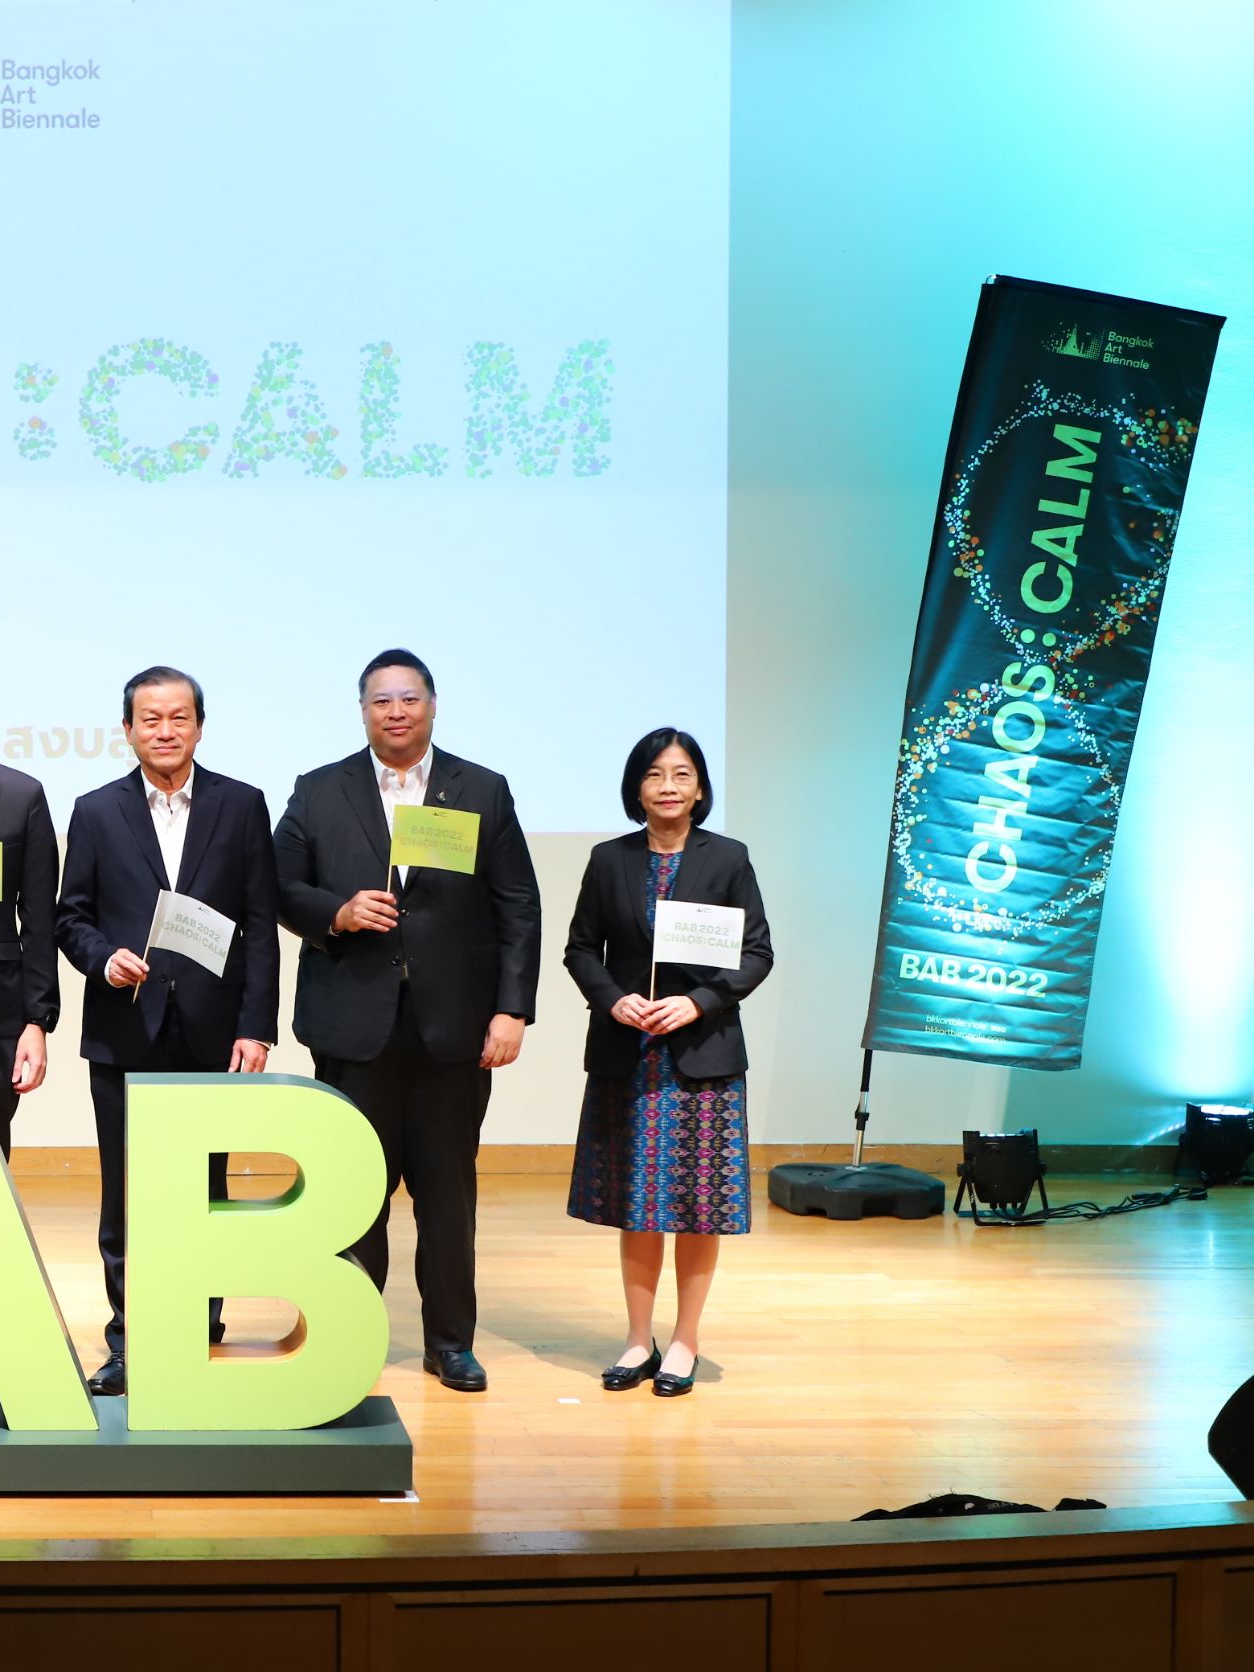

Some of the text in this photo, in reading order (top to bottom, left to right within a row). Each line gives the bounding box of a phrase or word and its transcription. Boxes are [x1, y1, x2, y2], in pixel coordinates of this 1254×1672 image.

[1, 59, 101, 86] Bangkok
[0, 84, 37, 105] Art
[1, 108, 101, 129] Biennale
[1105, 342, 1123, 354] Art
[1108, 331, 1154, 349] Bangkok
[1103, 352, 1150, 370] Biennale
[434, 828, 464, 841] 2022
[175, 913, 220, 942] BAB 2022
[674, 921, 730, 937] BAB 2022
[899, 953, 1049, 999] BAB 2022
